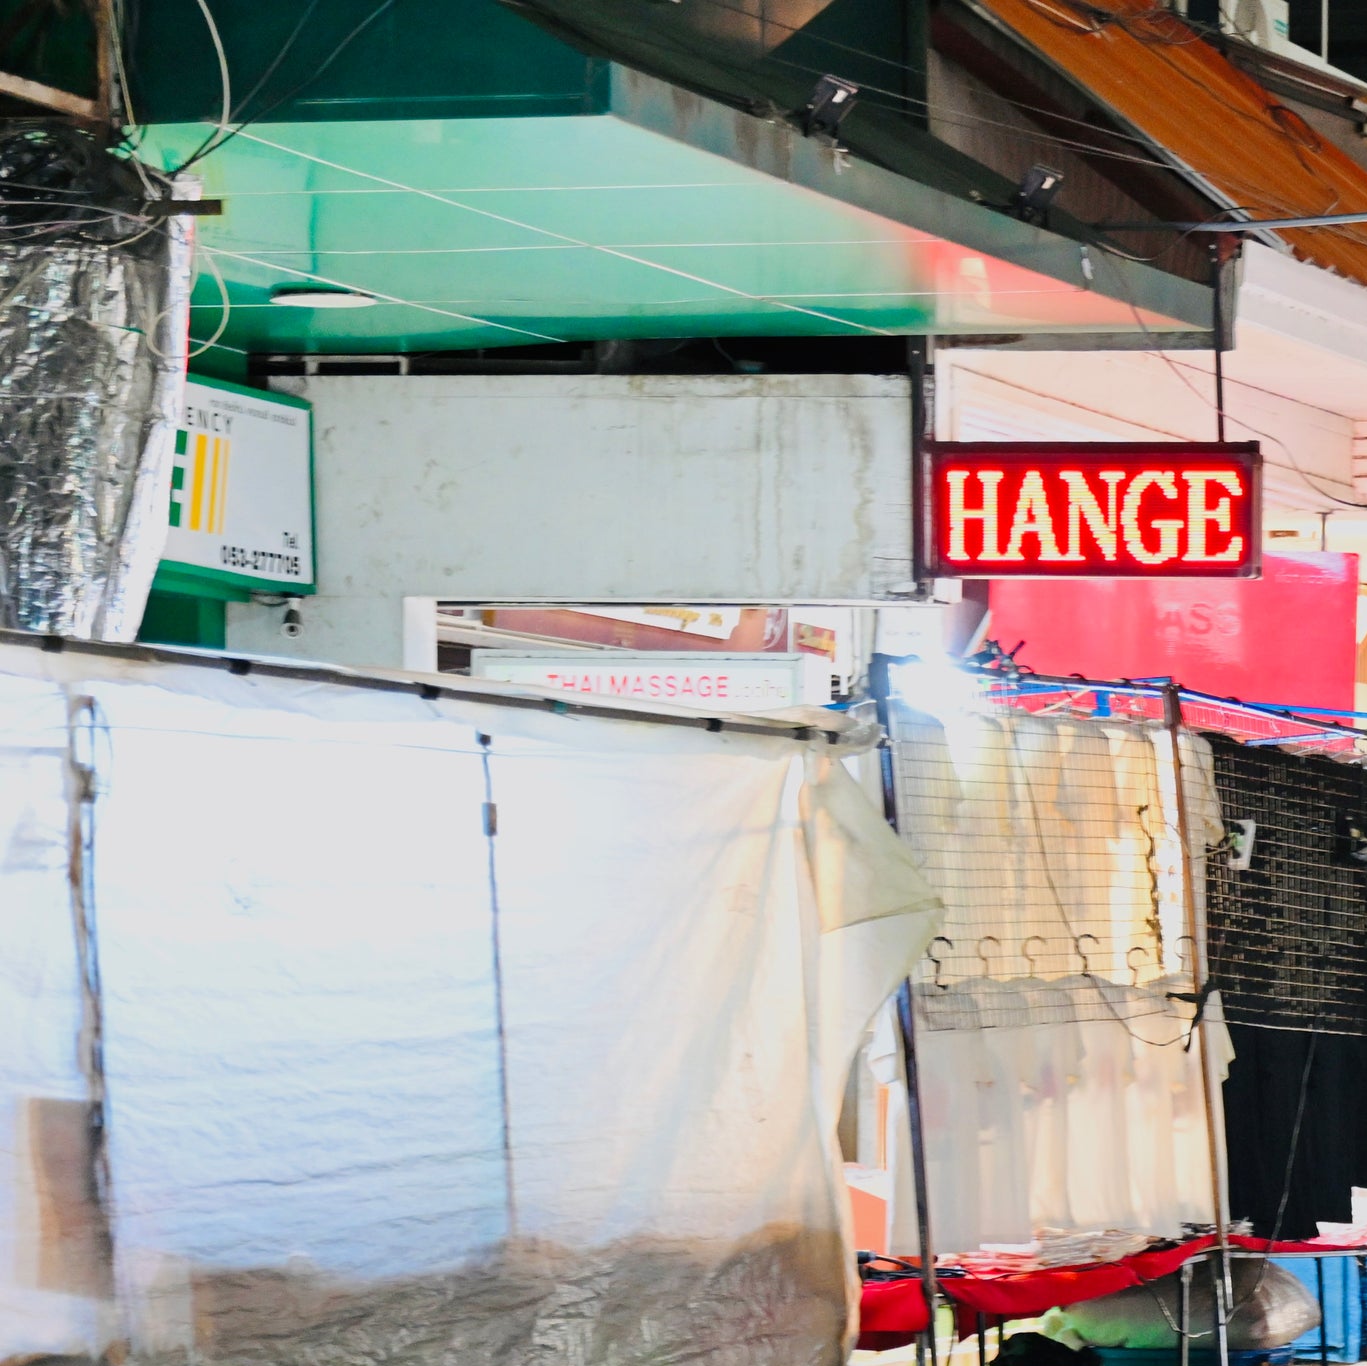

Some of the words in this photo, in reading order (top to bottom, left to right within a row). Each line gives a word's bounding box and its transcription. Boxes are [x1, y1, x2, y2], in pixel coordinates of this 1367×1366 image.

[946, 470, 1244, 565] HANGE
[547, 674, 602, 698] THAI
[609, 675, 729, 699] MASSAGE
